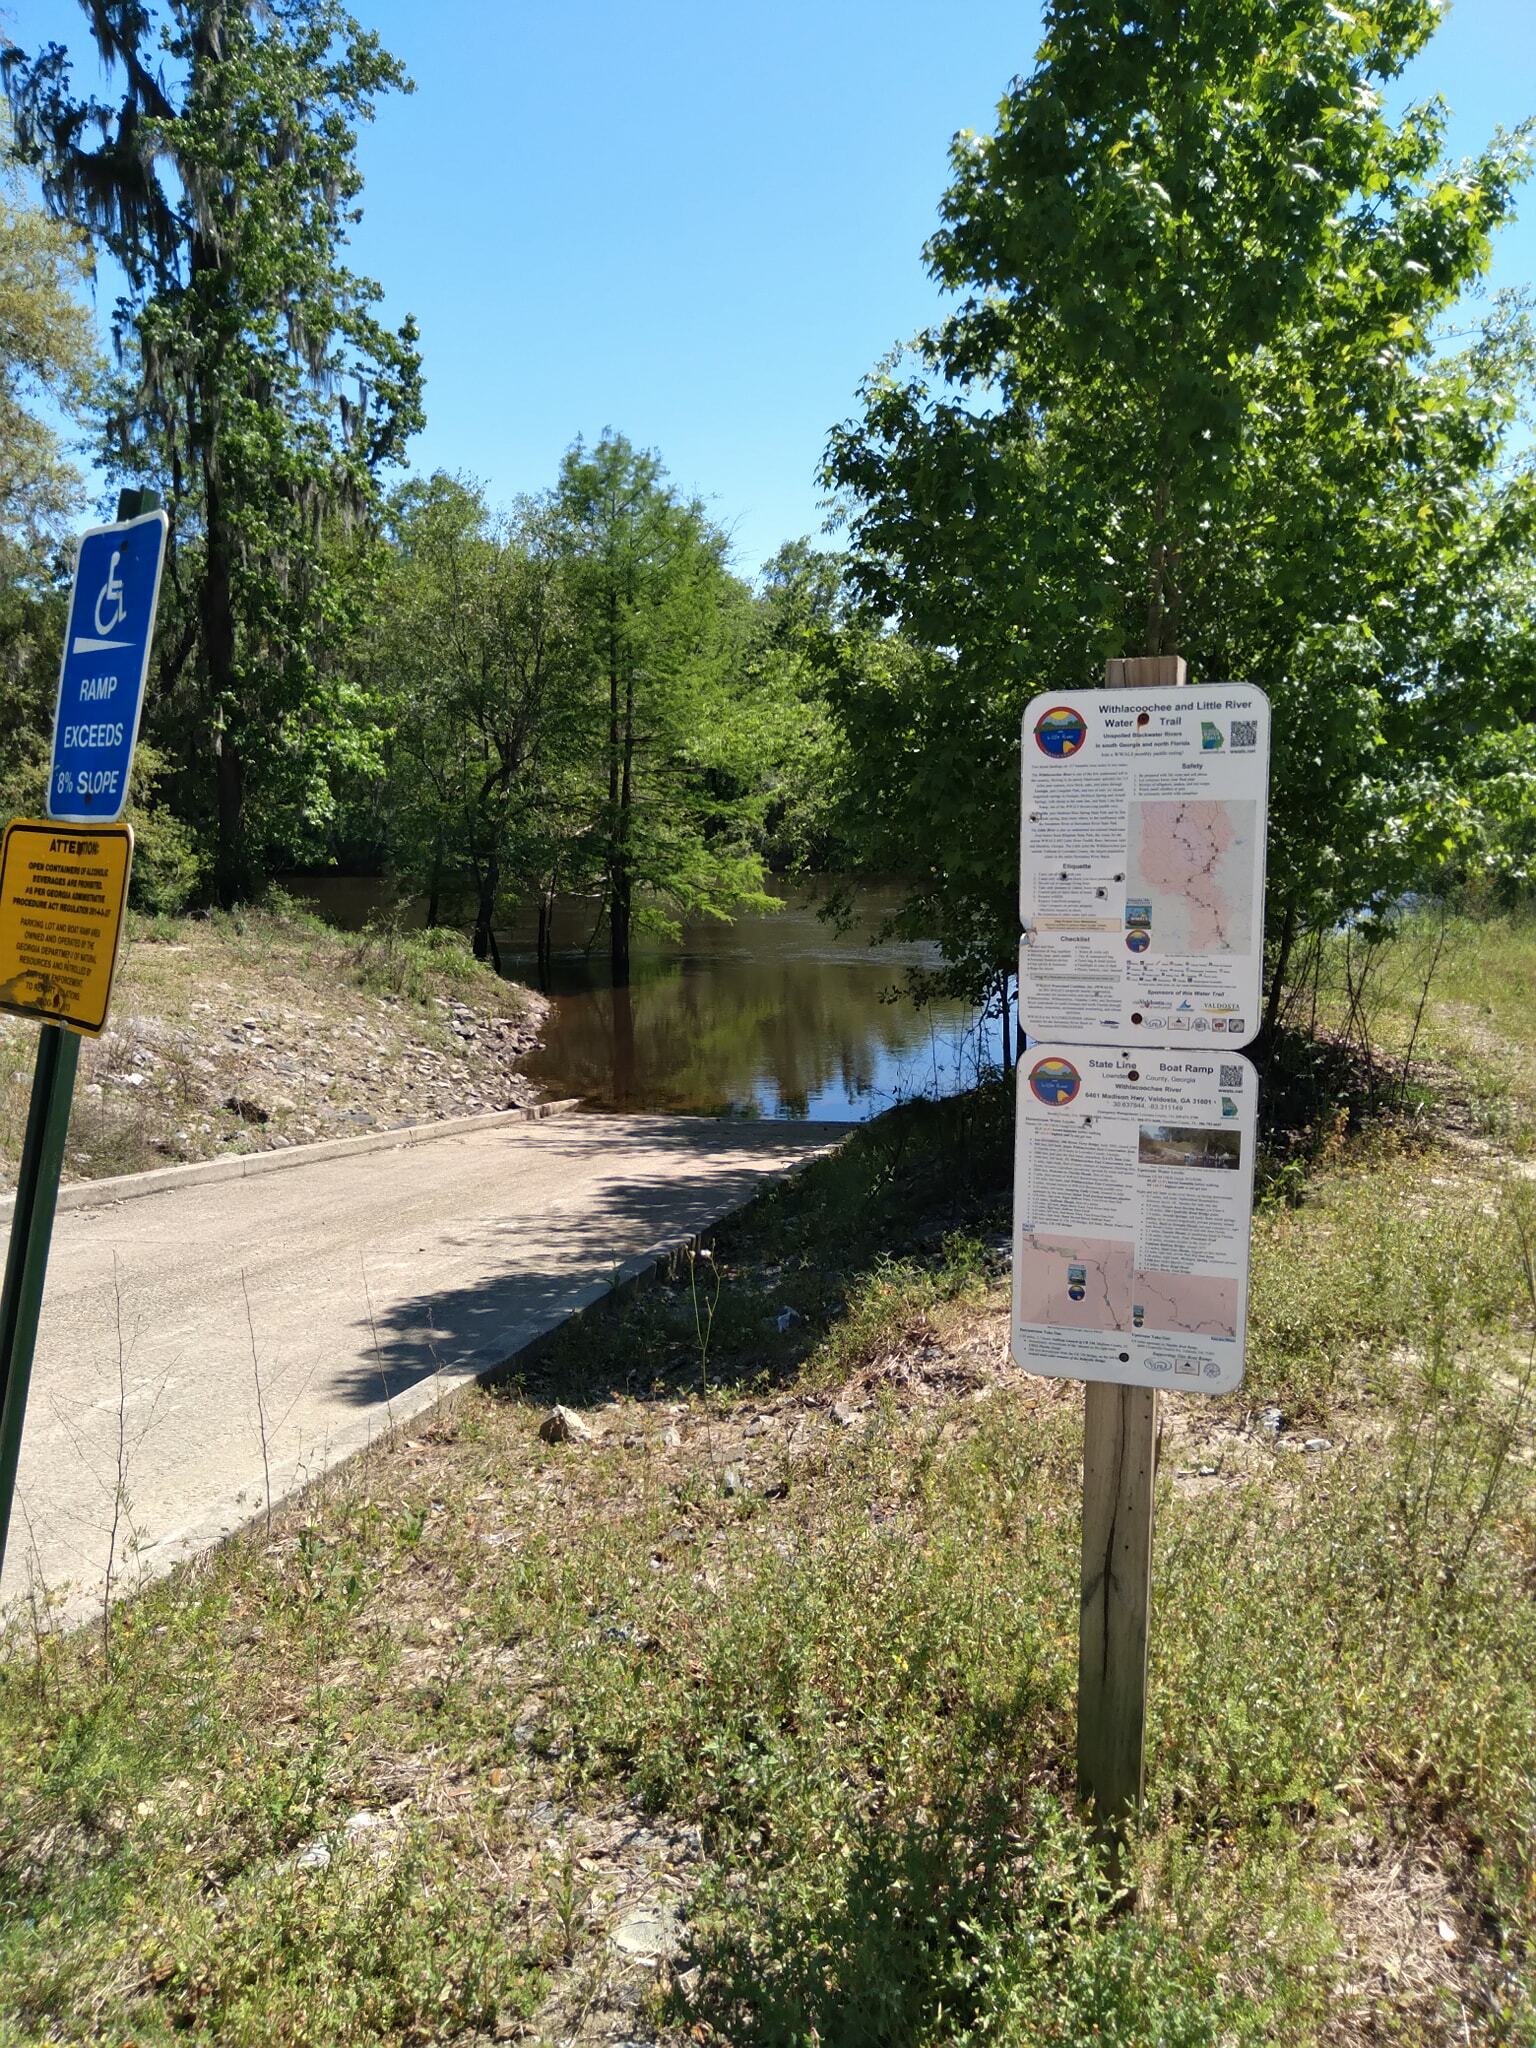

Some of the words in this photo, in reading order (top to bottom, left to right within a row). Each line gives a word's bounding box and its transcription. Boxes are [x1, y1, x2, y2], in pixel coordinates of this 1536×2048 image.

[80, 676, 117, 701] RAMP
[1098, 703, 1172, 714] Withlacoochee
[1175, 702, 1193, 711] and
[1197, 701, 1222, 710] Little
[1225, 700, 1252, 709] River
[1104, 719, 1133, 728] Water
[1160, 717, 1181, 726] Trail
[64, 723, 123, 748] EXCEEDS
[57, 771, 73, 794] 8%
[77, 770, 119, 794] SLOPE
[28, 862, 45, 871] OPEN
[45, 864, 80, 875] CONTAINERS
[32, 875, 66, 886] BEVERAGES
[67, 879, 77, 888] ARE
[34, 887, 46, 896] PER
[46, 889, 71, 899] GEORGIA
[12, 897, 47, 909] PROCEDURE
[48, 902, 60, 911] ACT
[20, 917, 43, 930] PARKING
[44, 921, 56, 930] LOT
[56, 923, 67, 933] AND
[24, 930, 45, 942] OWNED
[45, 933, 57, 944] AND
[57, 935, 80, 948] OPERATED
[16, 942, 40, 953] GEORGIA
[41, 946, 74, 959] DEPARTMENT
[19, 955, 52, 969] RESOURCES
[52, 961, 63, 971] AND
[1089, 1060, 1113, 1068] State
[1116, 1061, 1137, 1069] Line
[1160, 1063, 1182, 1072] Boat
[1185, 1064, 1214, 1074] Ramp
[1171, 1076, 1196, 1084] Georgia
[1115, 1083, 1163, 1092] Withlacoochee
